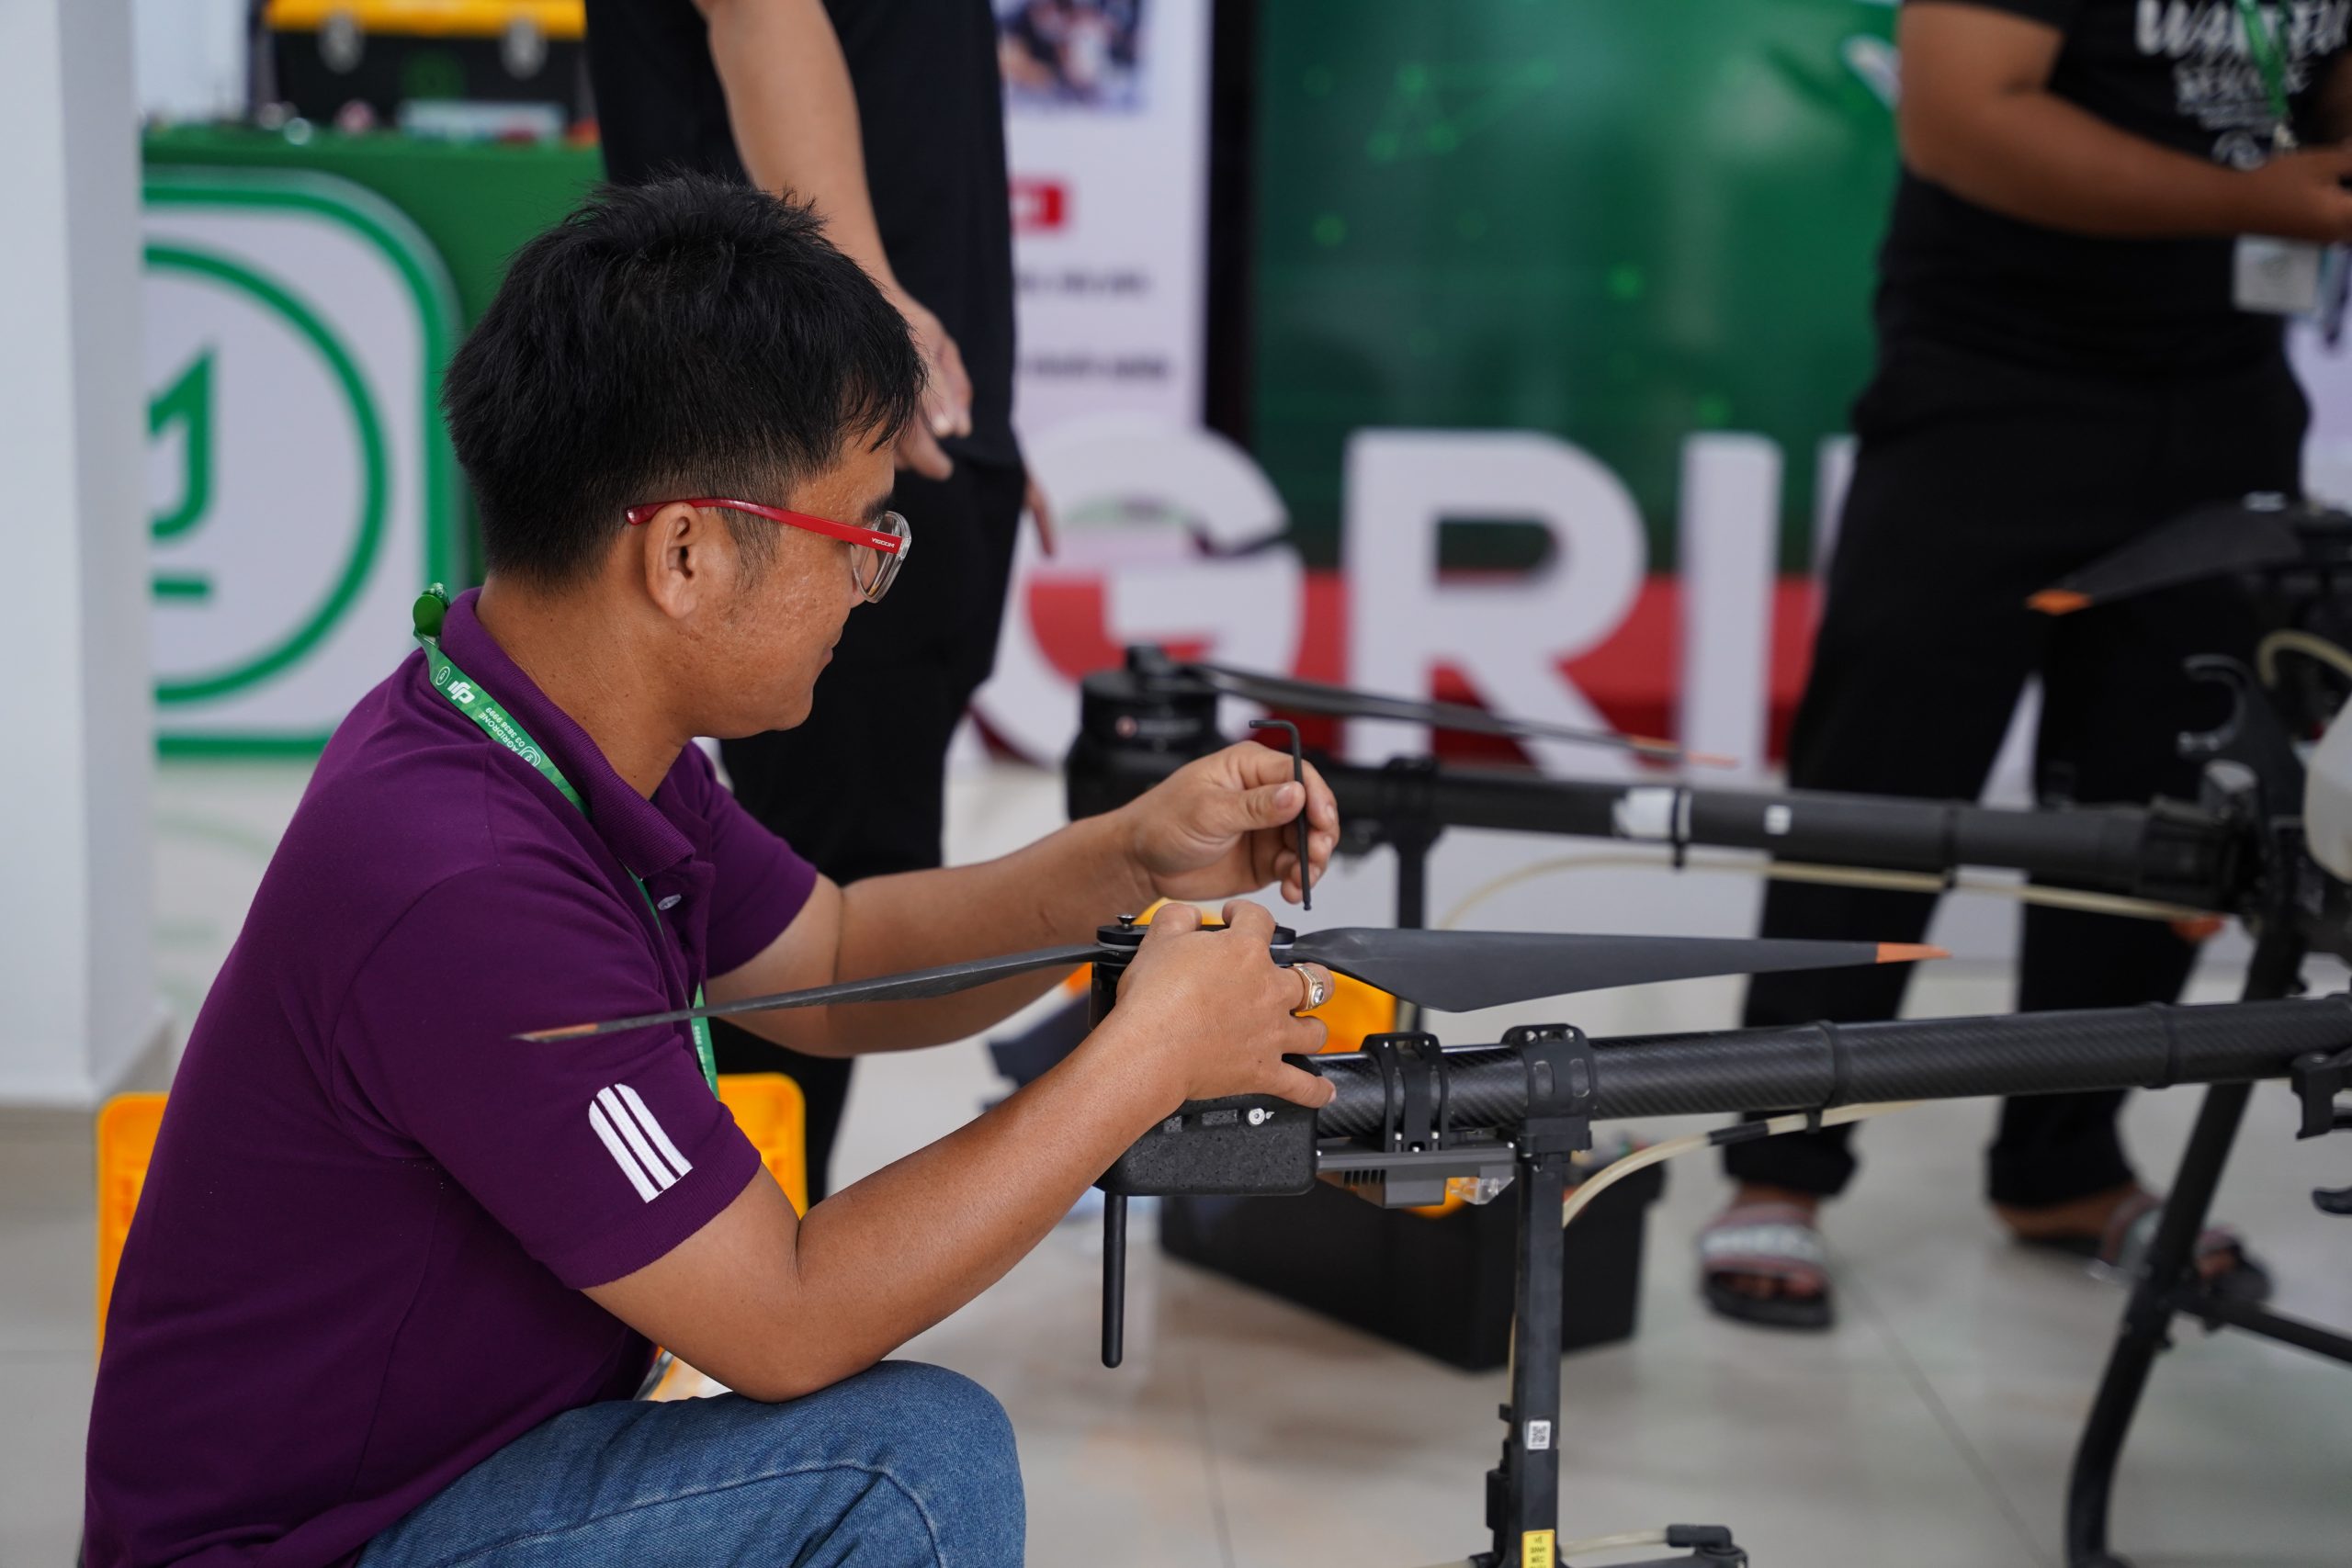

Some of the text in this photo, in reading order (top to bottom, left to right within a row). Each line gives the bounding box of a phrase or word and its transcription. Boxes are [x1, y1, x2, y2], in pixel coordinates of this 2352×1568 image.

[971, 412, 1858, 789] GRI
[479, 712, 519, 752] AGRIDRONE
[485, 707, 526, 748] 03 3838 9999
